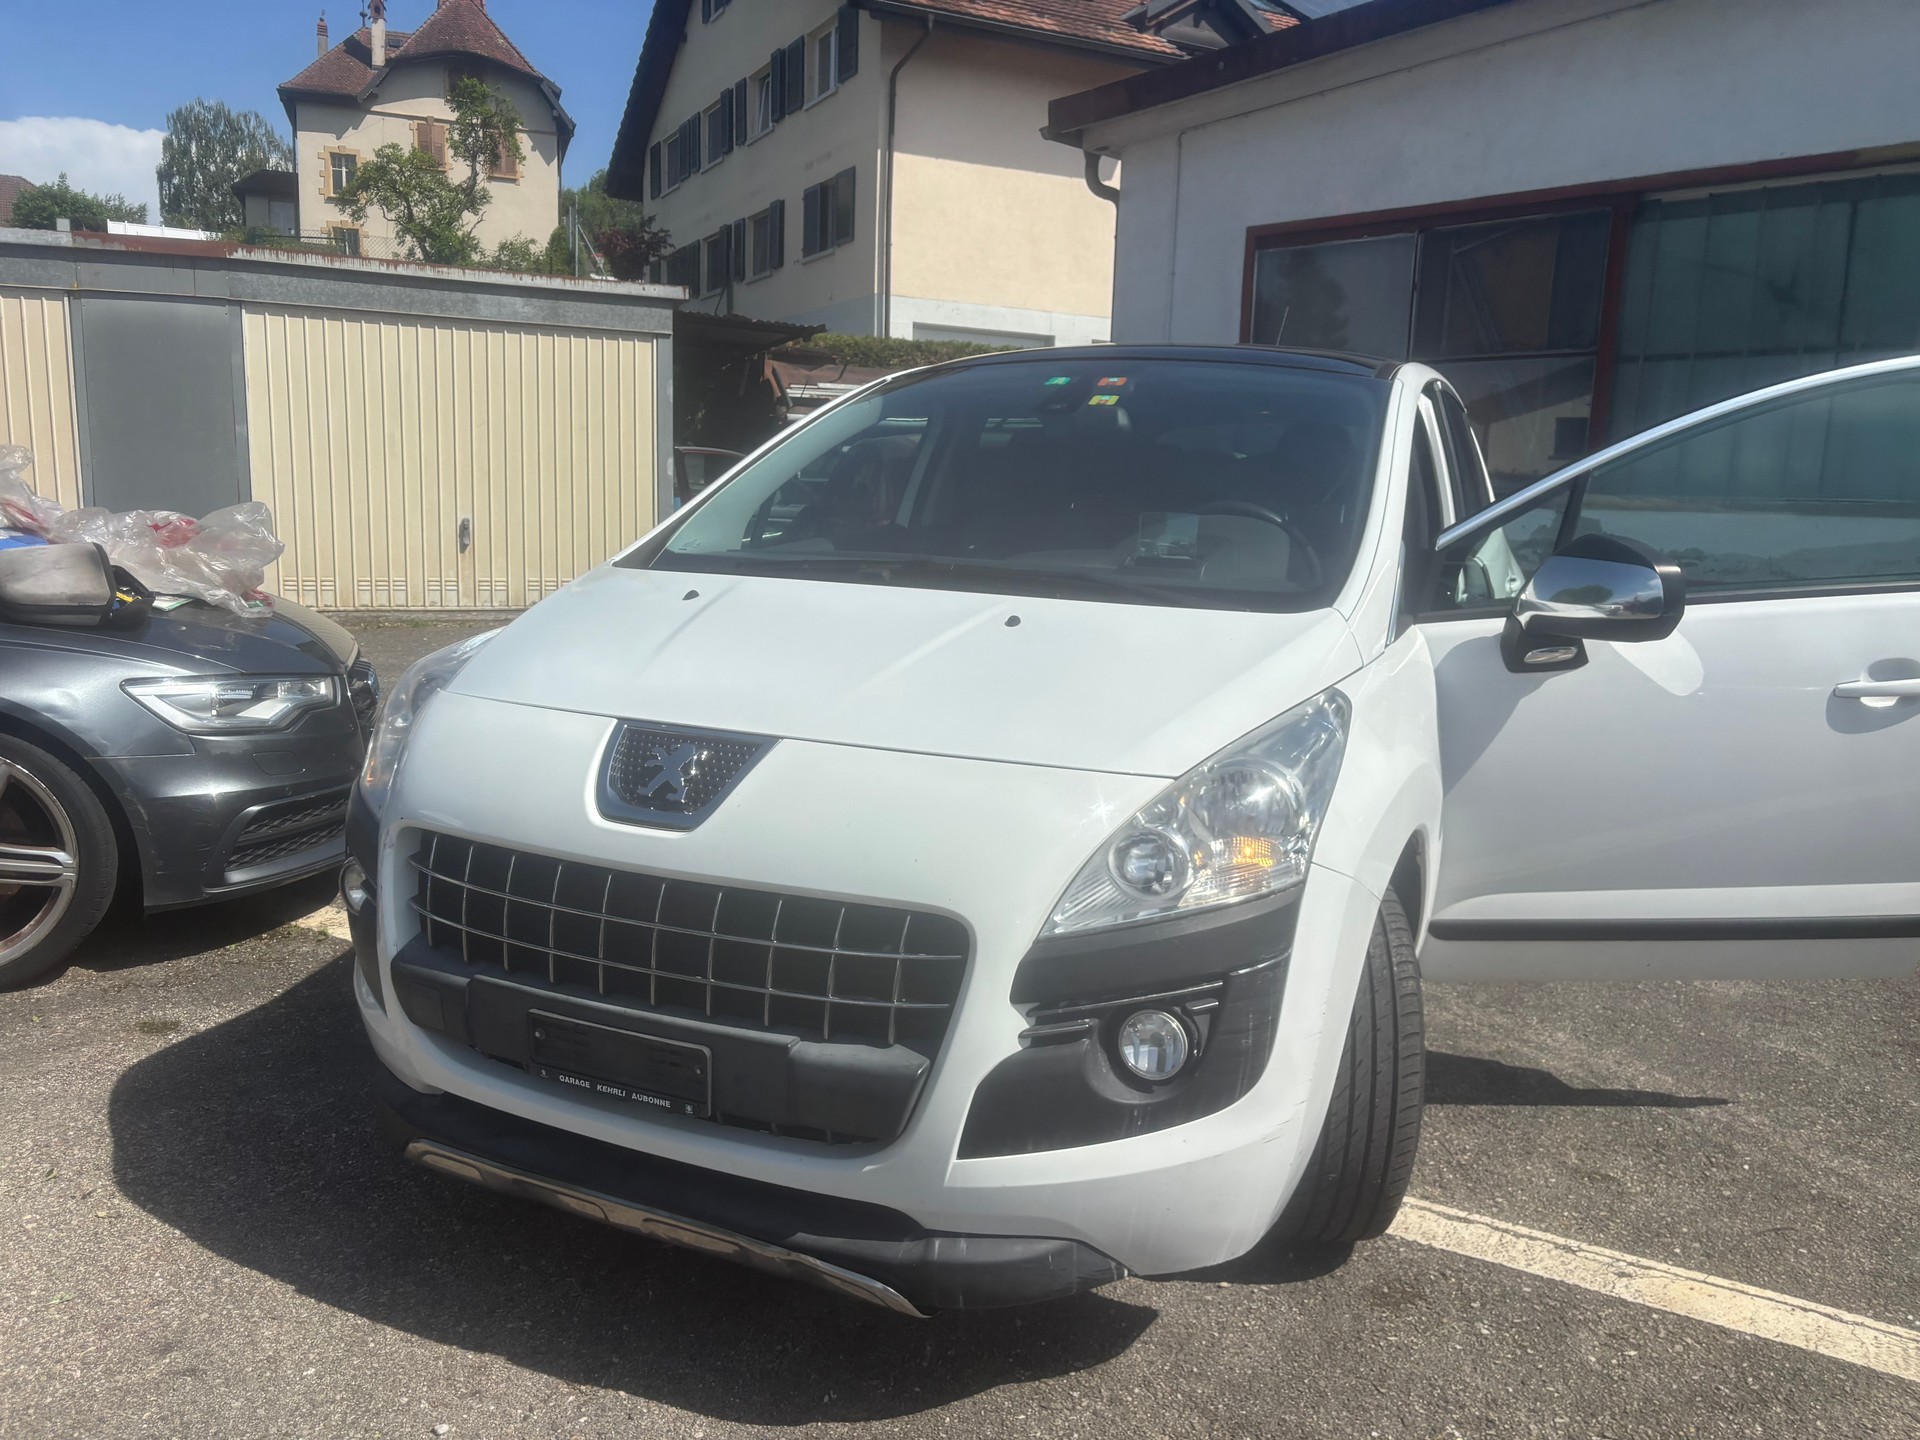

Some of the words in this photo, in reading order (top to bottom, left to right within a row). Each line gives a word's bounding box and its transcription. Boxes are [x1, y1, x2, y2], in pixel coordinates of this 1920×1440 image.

[559, 1075, 590, 1088] GARAGE
[597, 1084, 626, 1097] KEHRLI
[632, 1093, 671, 1108] AUBONNE
